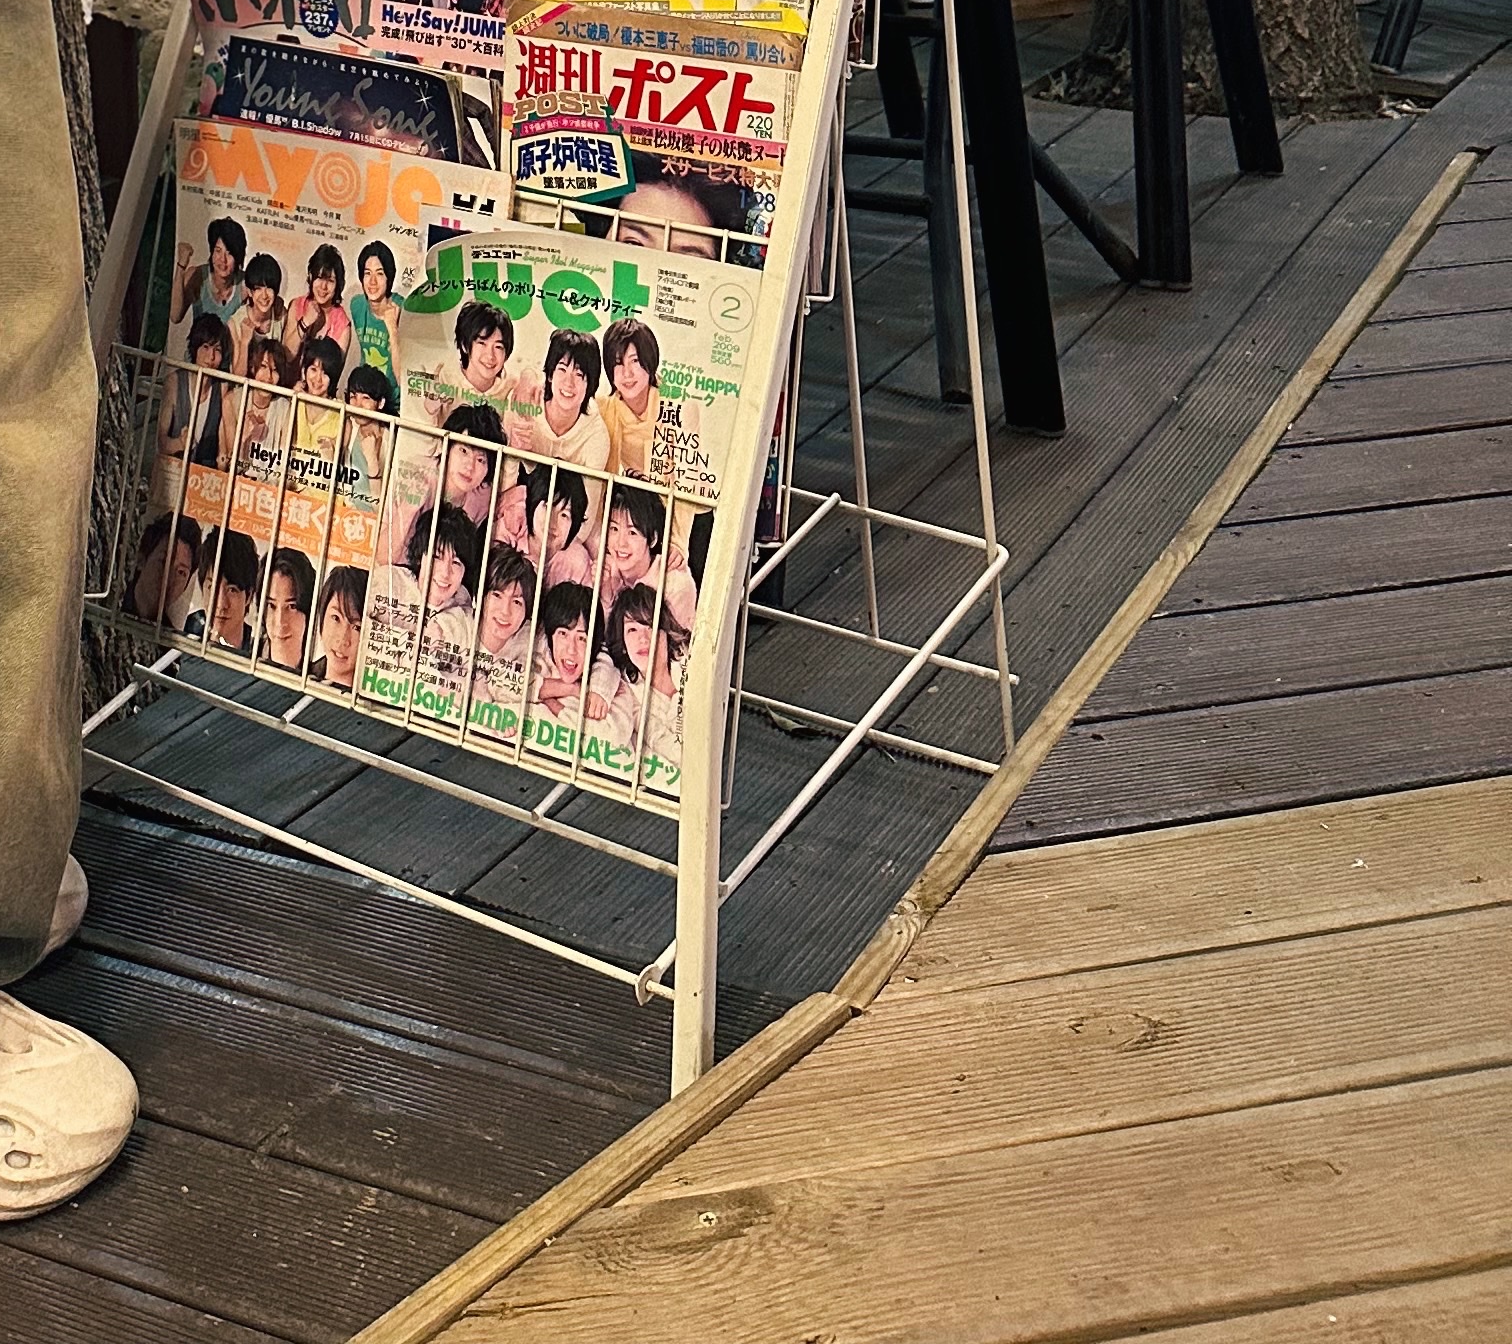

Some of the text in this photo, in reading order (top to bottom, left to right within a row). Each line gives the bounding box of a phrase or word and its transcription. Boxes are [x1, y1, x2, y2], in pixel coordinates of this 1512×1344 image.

[512, 91, 609, 123] POST
[746, 115, 774, 131] 220
[753, 128, 773, 140] YEN
[516, 136, 622, 181] 原子炉衛星
[471, 248, 523, 260] デュエット
[720, 296, 742, 320] 2
[712, 342, 740, 354] 2009
[660, 368, 742, 399] 2009 HAPPY
[656, 400, 683, 429] 嵐
[653, 424, 700, 450] NEWS
[249, 442, 283, 466] Hey!
[361, 666, 410, 705] Hey!
[413, 682, 457, 719] Say!
